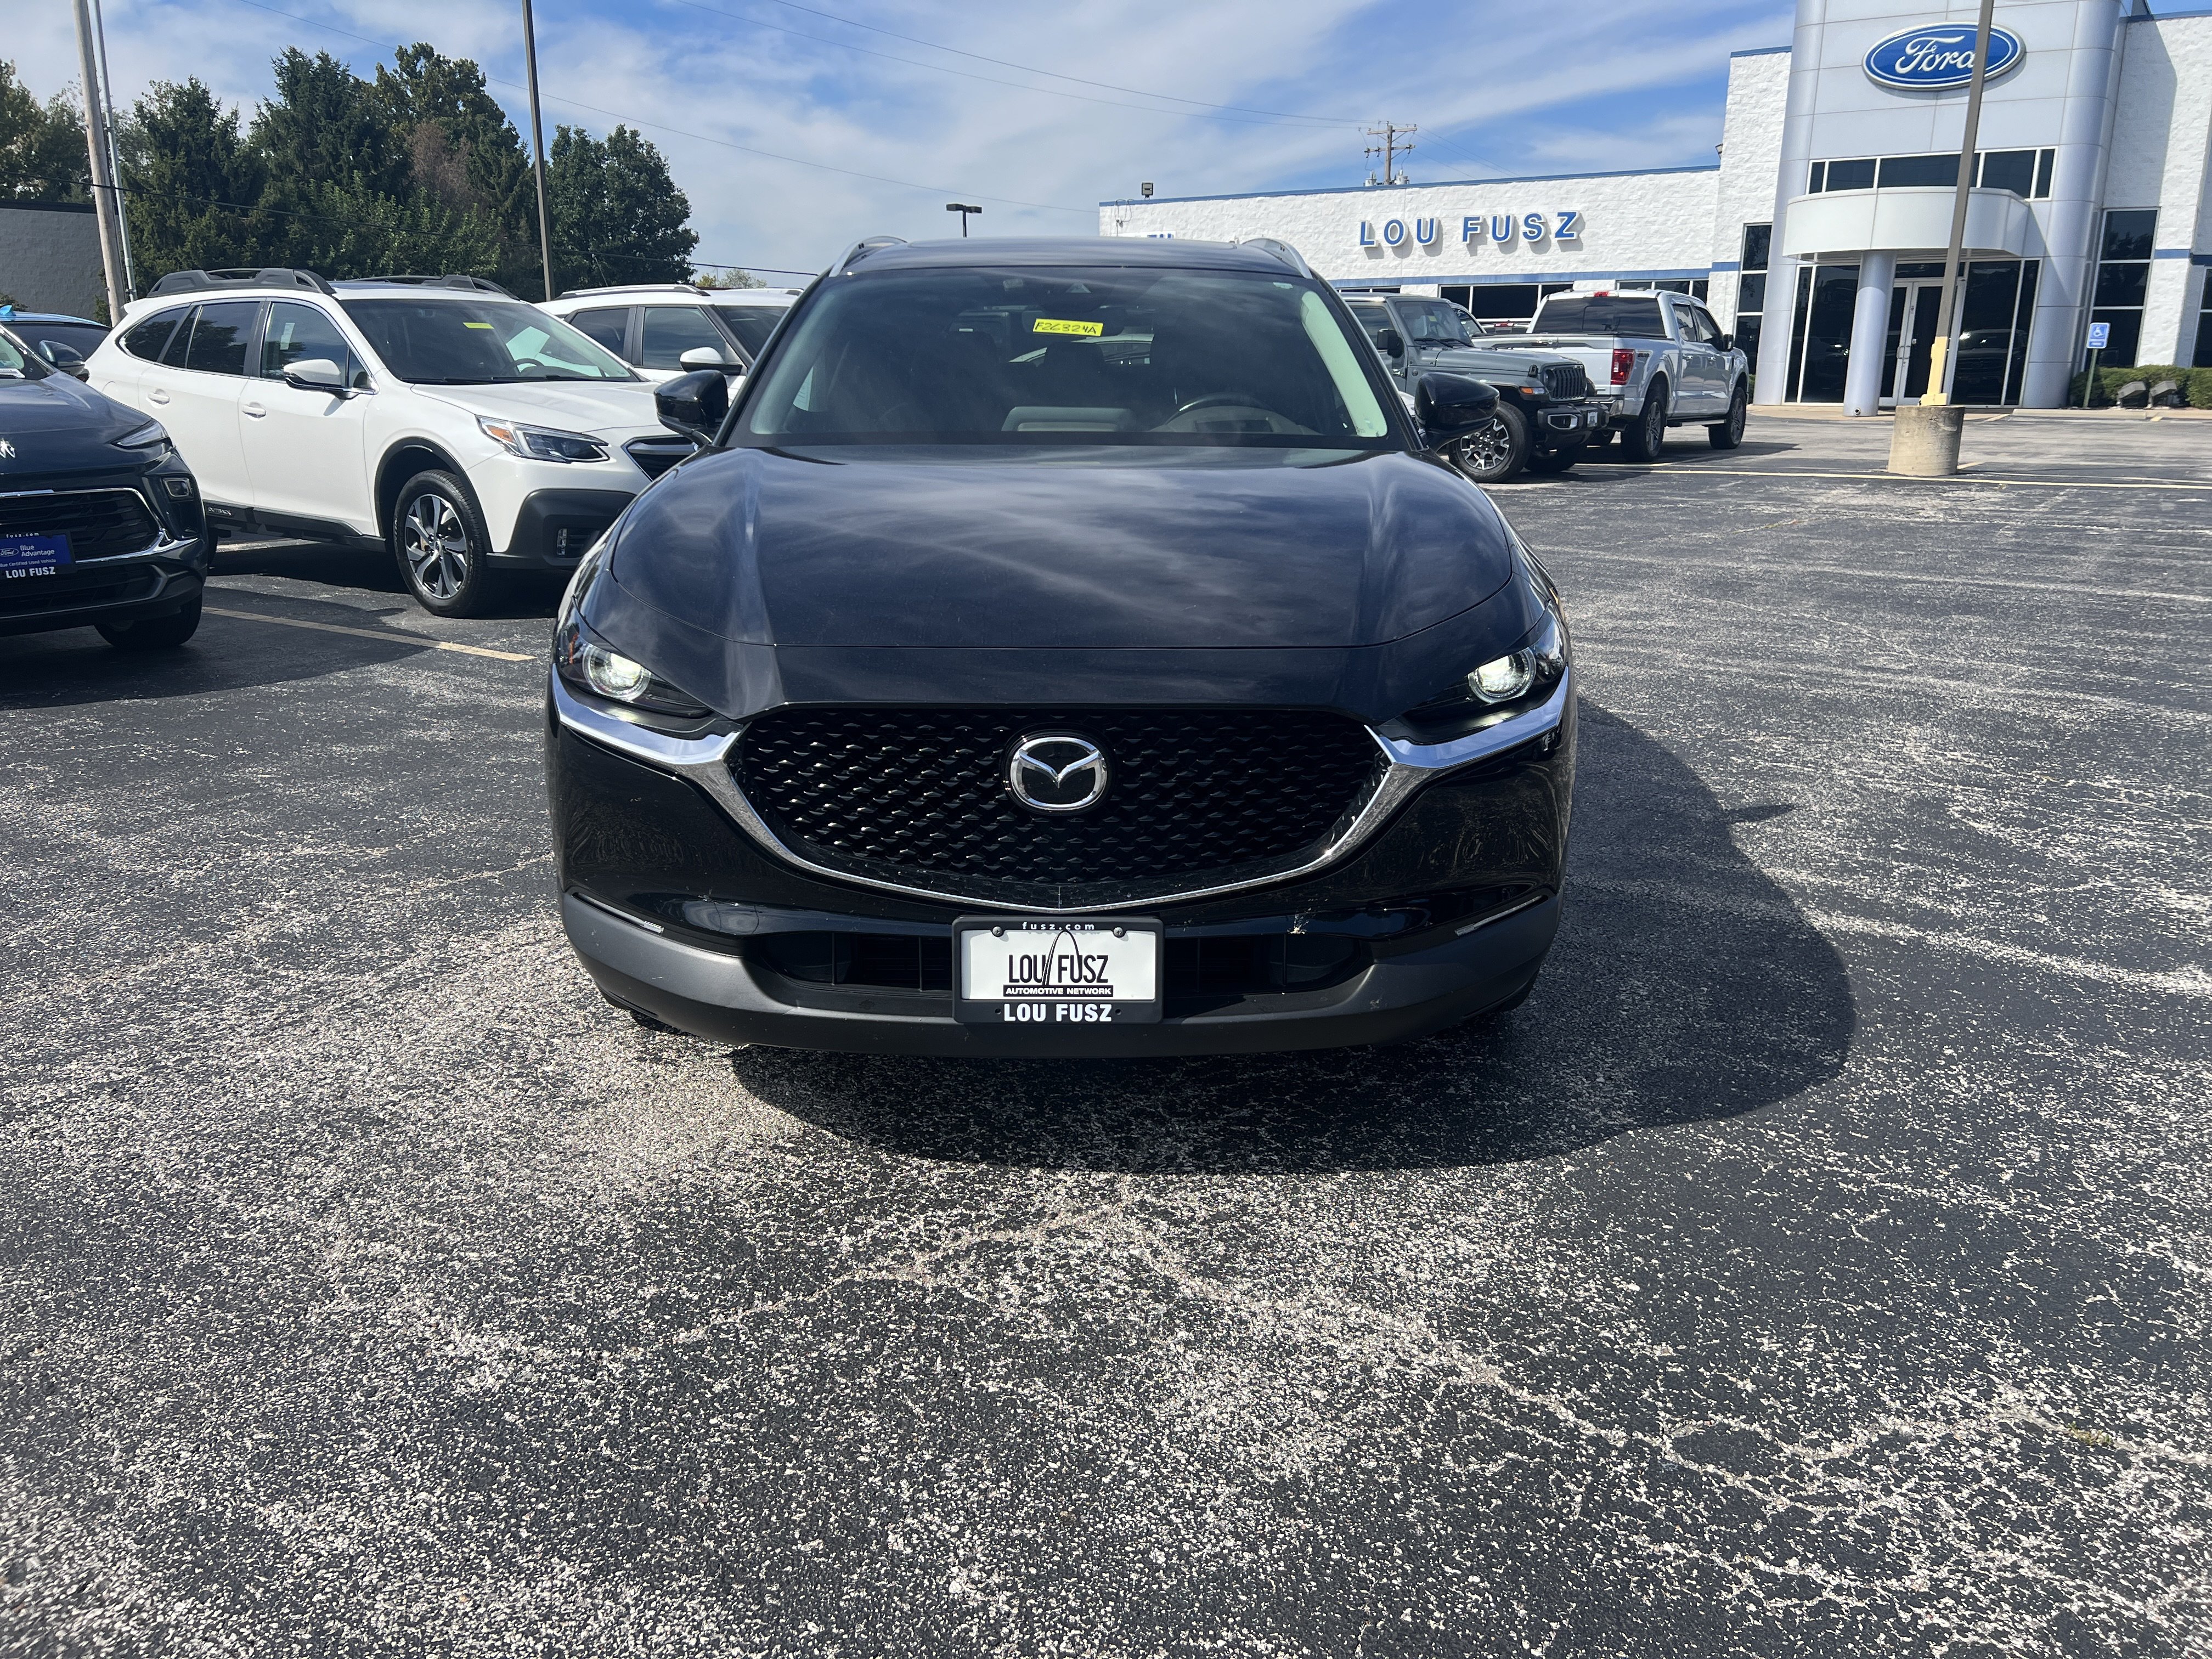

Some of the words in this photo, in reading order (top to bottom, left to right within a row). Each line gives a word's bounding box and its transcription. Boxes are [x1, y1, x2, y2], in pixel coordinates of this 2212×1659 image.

[1359, 217, 1439, 247] LOU
[1462, 211, 1579, 243] FUSZ
[5, 569, 26, 578] LOU
[29, 566, 56, 576] FUSZ
[1022, 922, 1094, 930] fusz.com
[1009, 955, 1046, 983] LOU
[1058, 955, 1108, 983] FUSZ
[1004, 1003, 1046, 1022] LOU
[1056, 1003, 1112, 1022] FUSZ
